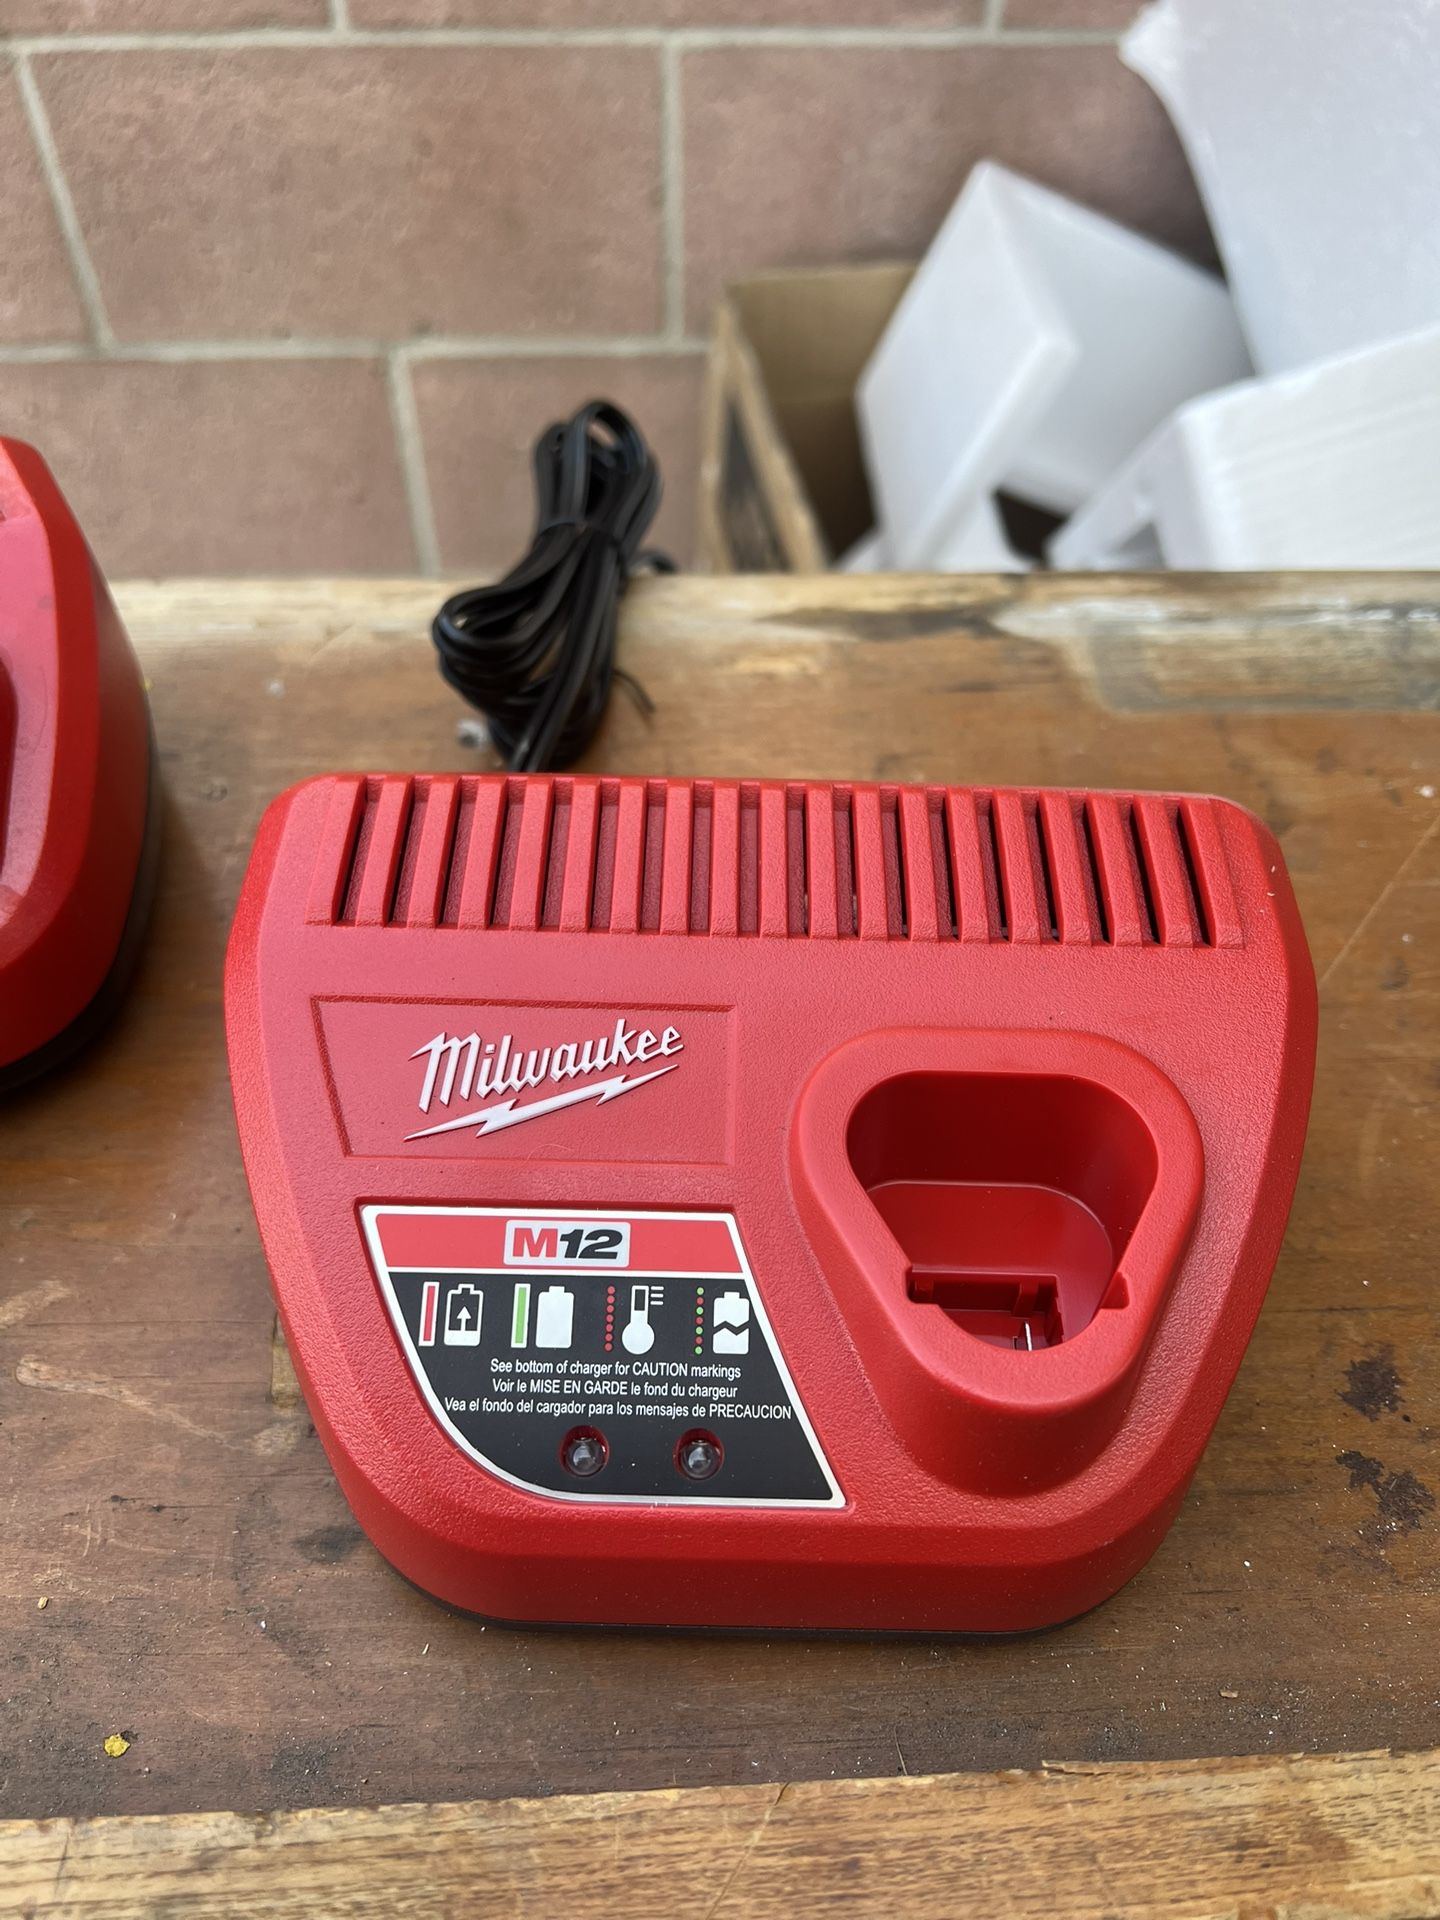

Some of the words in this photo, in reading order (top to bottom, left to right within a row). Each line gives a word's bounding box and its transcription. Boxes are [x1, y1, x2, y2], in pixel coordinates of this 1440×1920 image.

[408, 1018, 684, 1114] Milwaukee
[512, 1227, 624, 1259] M12
[491, 1358, 512, 1372] See
[516, 1359, 553, 1373] bottom
[556, 1360, 568, 1373] of
[570, 1361, 612, 1377] charger
[615, 1362, 630, 1375] for
[633, 1362, 688, 1376] CAUTION
[691, 1364, 741, 1381] markings
[492, 1378, 514, 1392] Voir
[517, 1379, 527, 1392] le
[530, 1379, 560, 1393] MISE
[564, 1380, 581, 1394] EN
[584, 1381, 627, 1395] GARDE
[631, 1382, 641, 1395] le
[644, 1382, 668, 1396] fond
[671, 1383, 685, 1396] du
[688, 1384, 738, 1400] chargeur
[445, 1397, 466, 1410] Vea
[469, 1398, 479, 1411] el
[482, 1398, 513, 1412] fondo
[517, 1399, 533, 1412] del
[536, 1400, 585, 1416] cargador
[589, 1403, 614, 1417] para
[617, 1402, 632, 1415] los
[636, 1404, 688, 1419] mensajes
[692, 1404, 705, 1416] de
[709, 1404, 791, 1419] PRECAUCION
